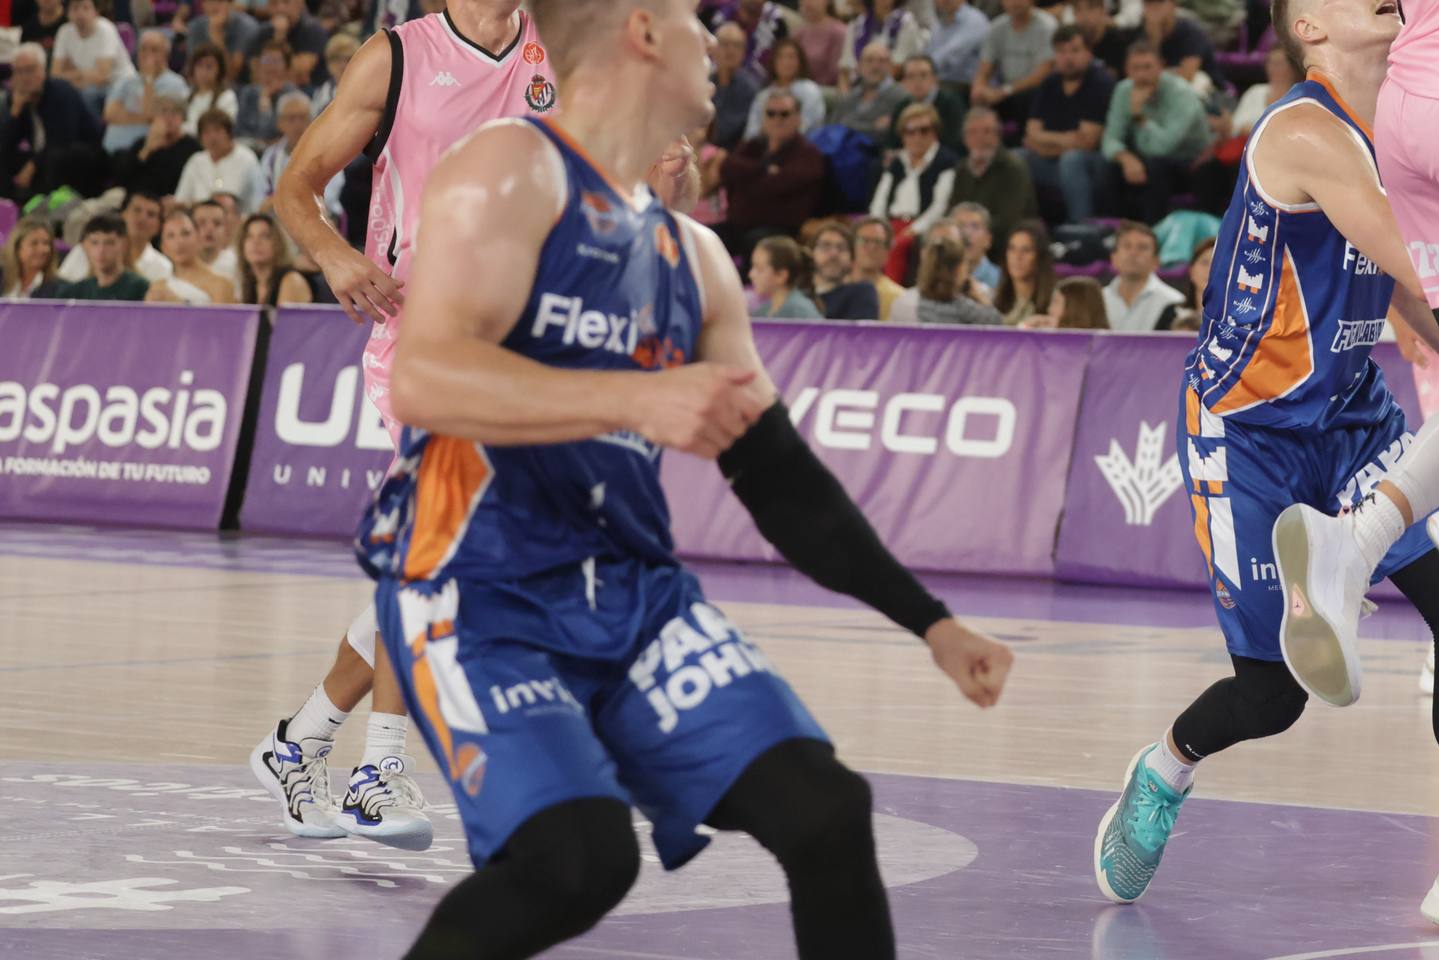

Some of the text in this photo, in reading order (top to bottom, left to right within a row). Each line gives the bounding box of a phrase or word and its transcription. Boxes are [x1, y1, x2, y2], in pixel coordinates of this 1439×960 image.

[0, 371, 227, 454] aspasia
[99, 461, 120, 480] DE
[123, 462, 145, 481] TU
[146, 463, 211, 485] FUTURO
